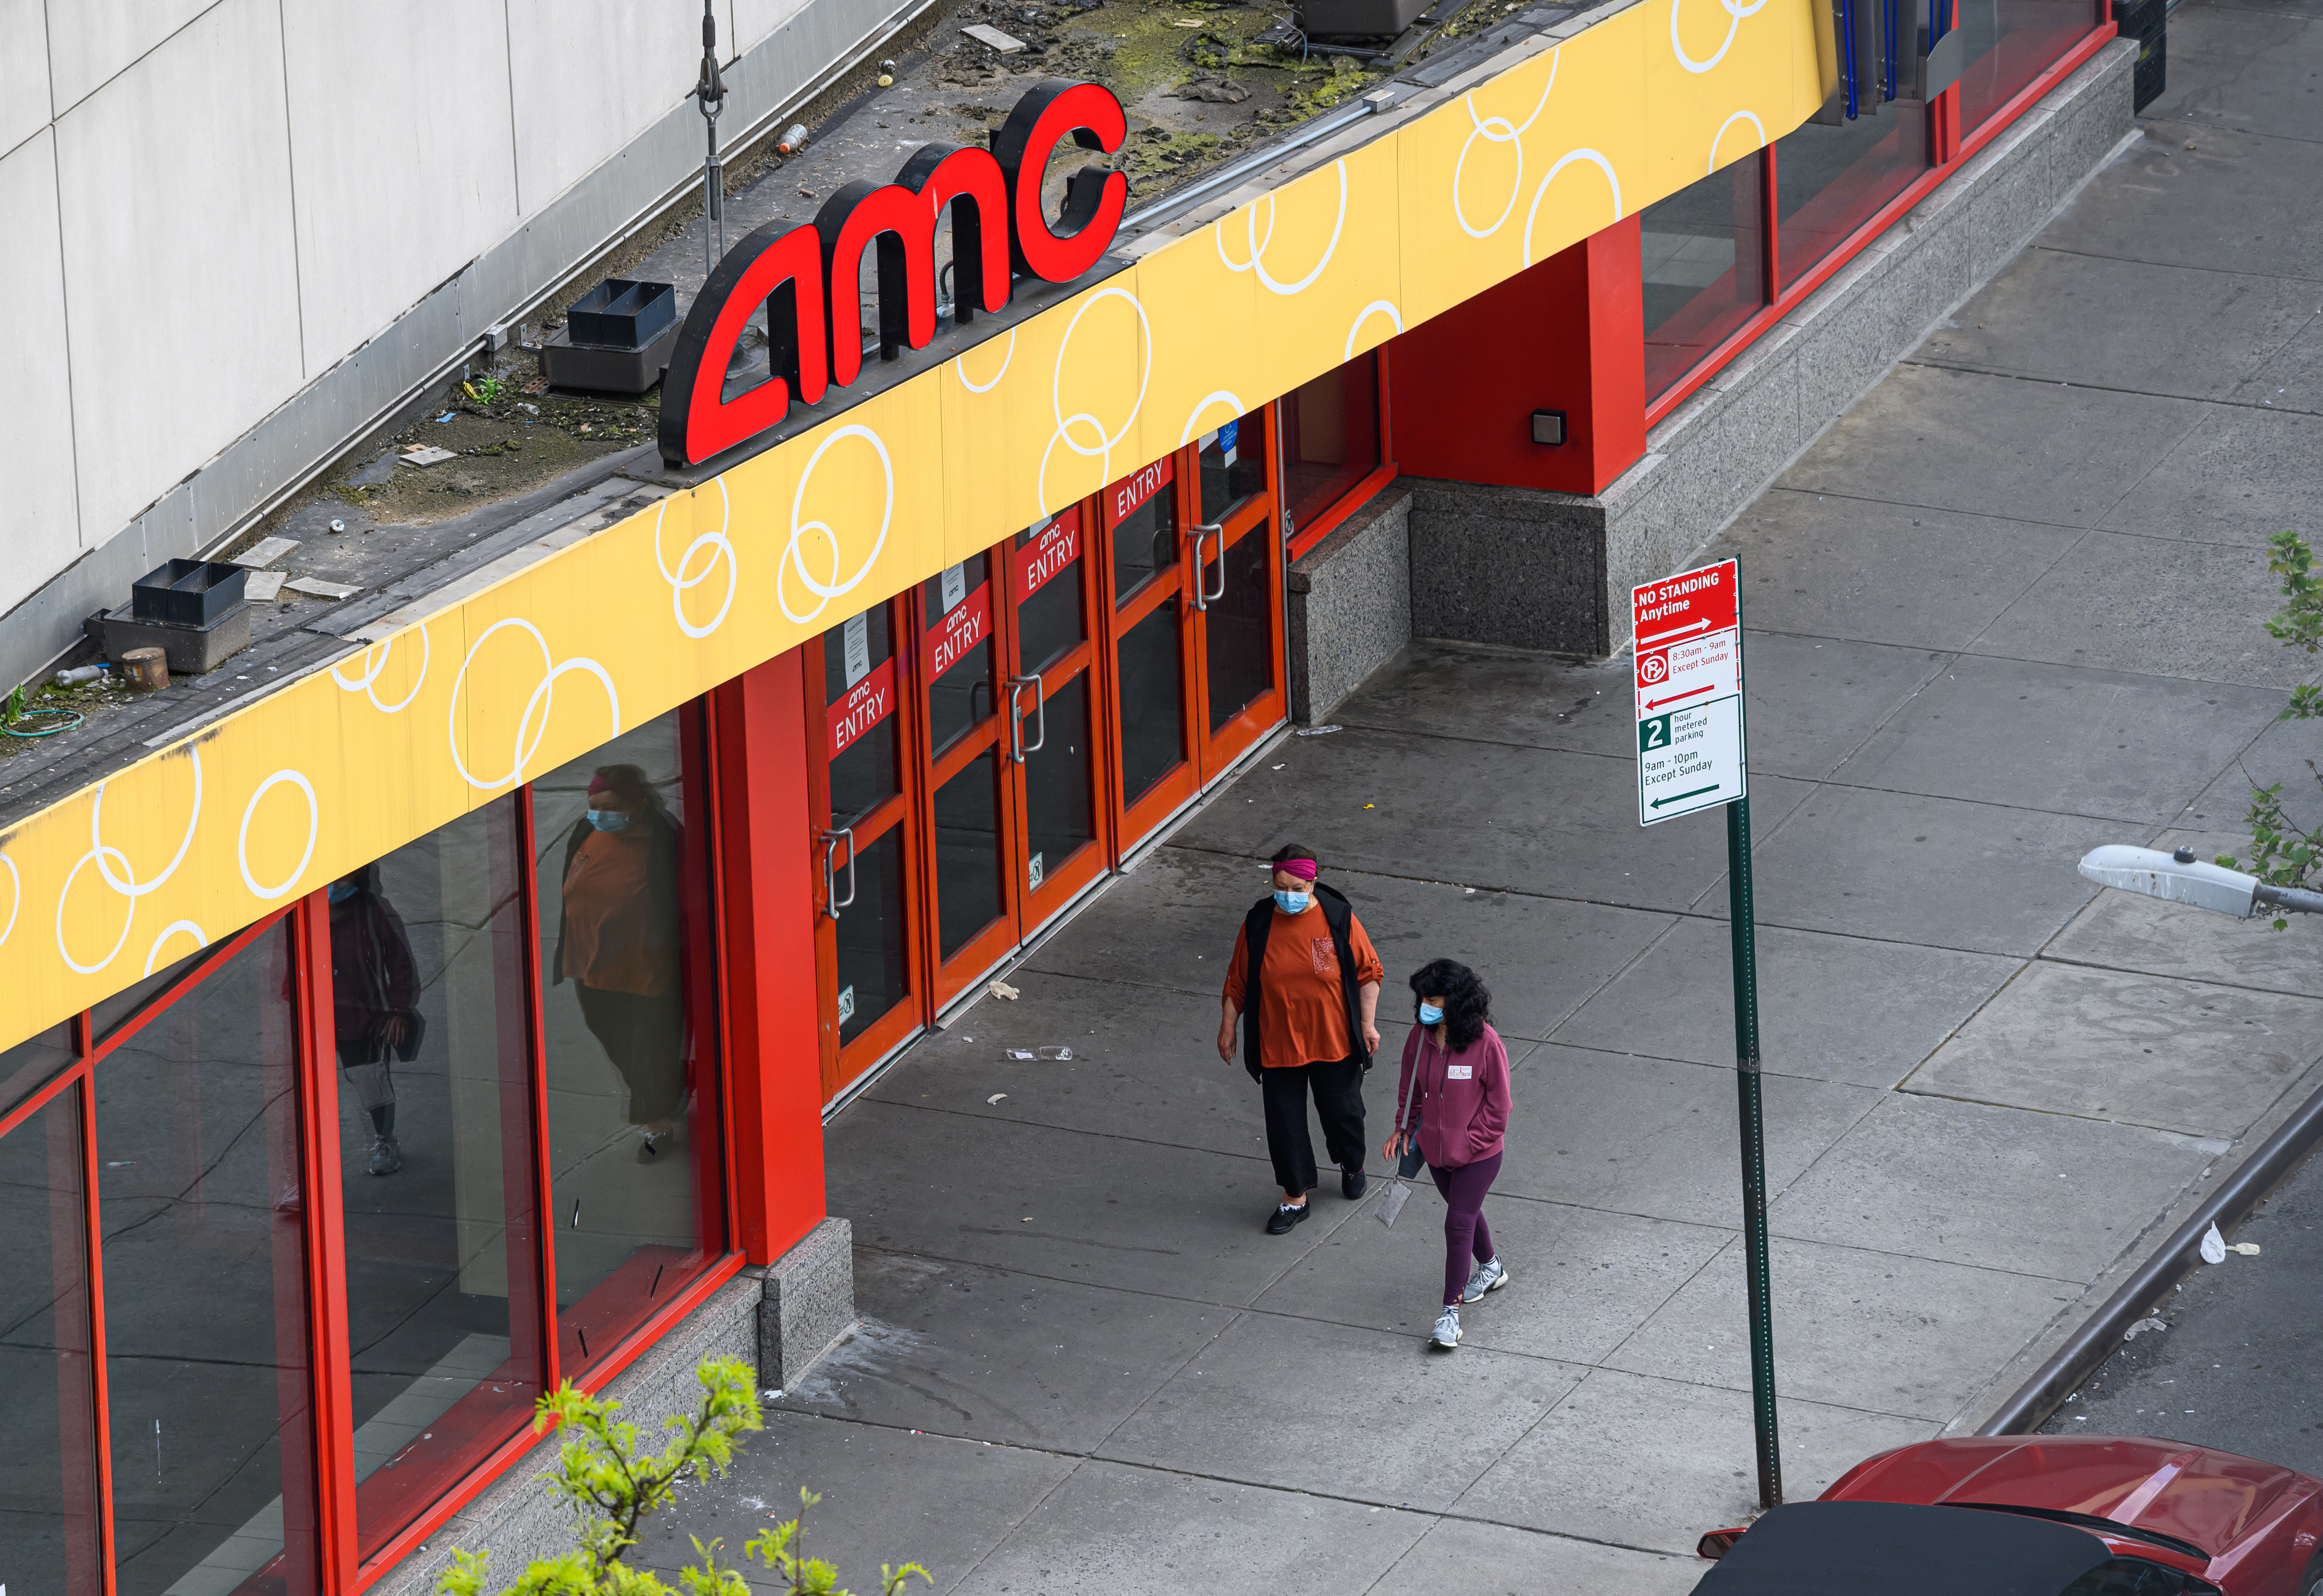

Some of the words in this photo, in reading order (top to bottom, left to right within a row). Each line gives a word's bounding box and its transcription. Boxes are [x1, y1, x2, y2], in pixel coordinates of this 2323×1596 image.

[1118, 457, 1163, 518] ENTRY
[1028, 530, 1075, 590] ENTRY
[1639, 590, 1656, 606] NO
[1659, 572, 1719, 600] STANDING
[1640, 599, 1690, 623] Anytime
[935, 611, 981, 673] ENTRY
[1673, 647, 1701, 661] 8:30am
[1709, 640, 1726, 650] 9am
[1673, 659, 1698, 674] Except
[1701, 652, 1728, 666] Sunday
[836, 687, 885, 749] ENTRY
[1674, 712, 1692, 723] hour
[1675, 716, 1707, 733] metered
[1647, 719, 1663, 748] 2
[1675, 730, 1703, 745] parking
[1645, 760, 1664, 772] 9am
[1674, 751, 1698, 764] 10pm
[1645, 768, 1676, 786] Except
[1679, 760, 1712, 776] Sunday
